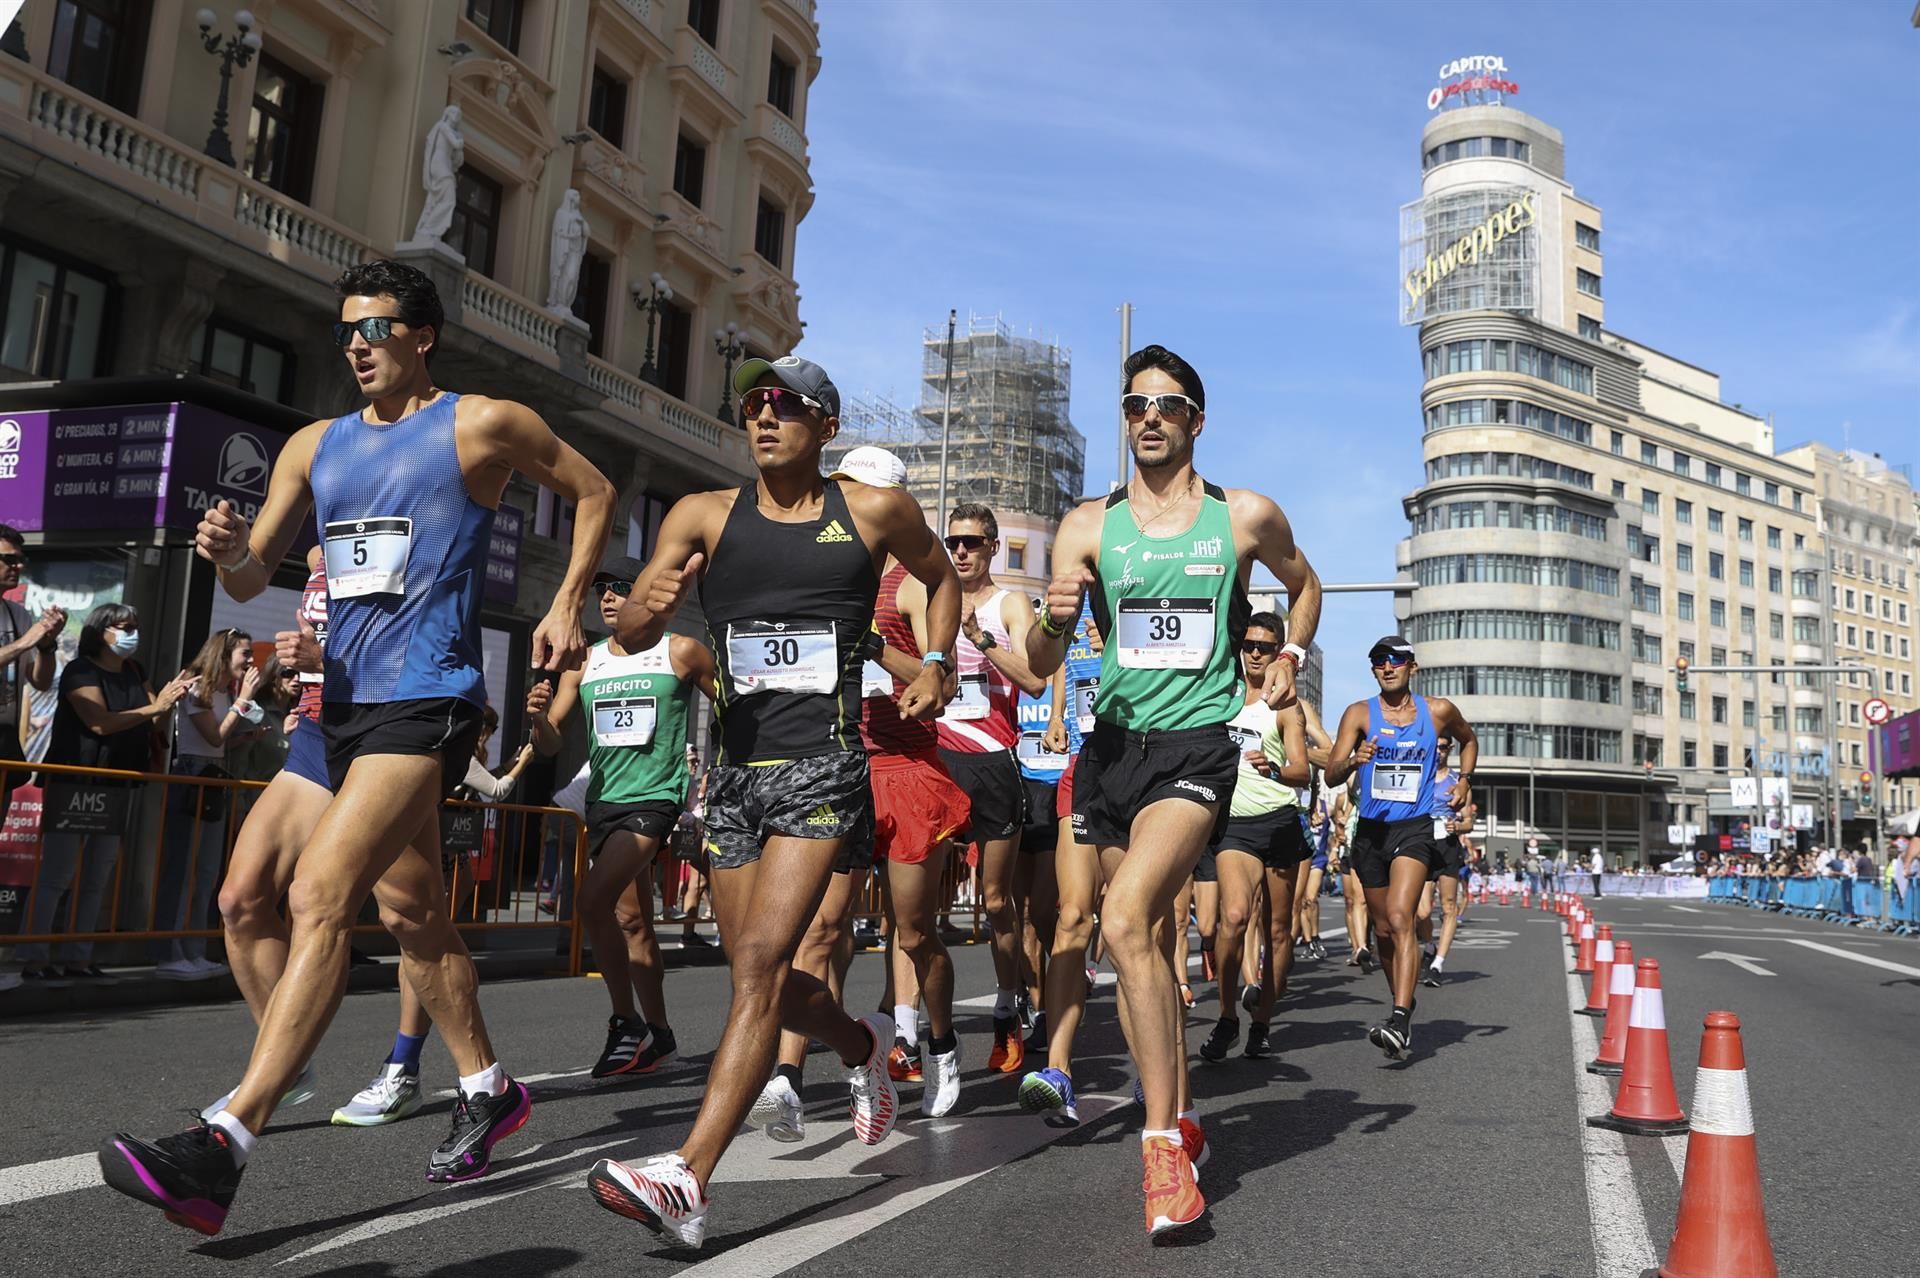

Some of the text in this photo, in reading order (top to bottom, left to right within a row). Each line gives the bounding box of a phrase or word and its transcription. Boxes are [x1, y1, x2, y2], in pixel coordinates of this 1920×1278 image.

[1440, 55, 1508, 79] CAPITOL
[1406, 191, 1536, 314] Schweppes
[125, 421, 135, 435] 2
[137, 419, 159, 434] MIN
[121, 449, 132, 464] 4
[133, 448, 155, 463] MIN
[844, 460, 877, 470] CHINA
[63, 481, 83, 495] GRAN
[119, 479, 128, 494] 5
[129, 477, 151, 492] MIN
[816, 533, 853, 543] adidas
[352, 539, 368, 566] 5
[1149, 615, 1182, 641] 39
[763, 638, 799, 667] 30
[594, 679, 652, 696] EJÉRCITO
[614, 710, 634, 728] 23
[1017, 704, 1069, 723] IND
[1389, 774, 1406, 787] 17
[1736, 784, 1752, 797] M
[69, 791, 107, 812] AMS
[452, 817, 472, 831] AMS
[806, 815, 840, 827] adidas
